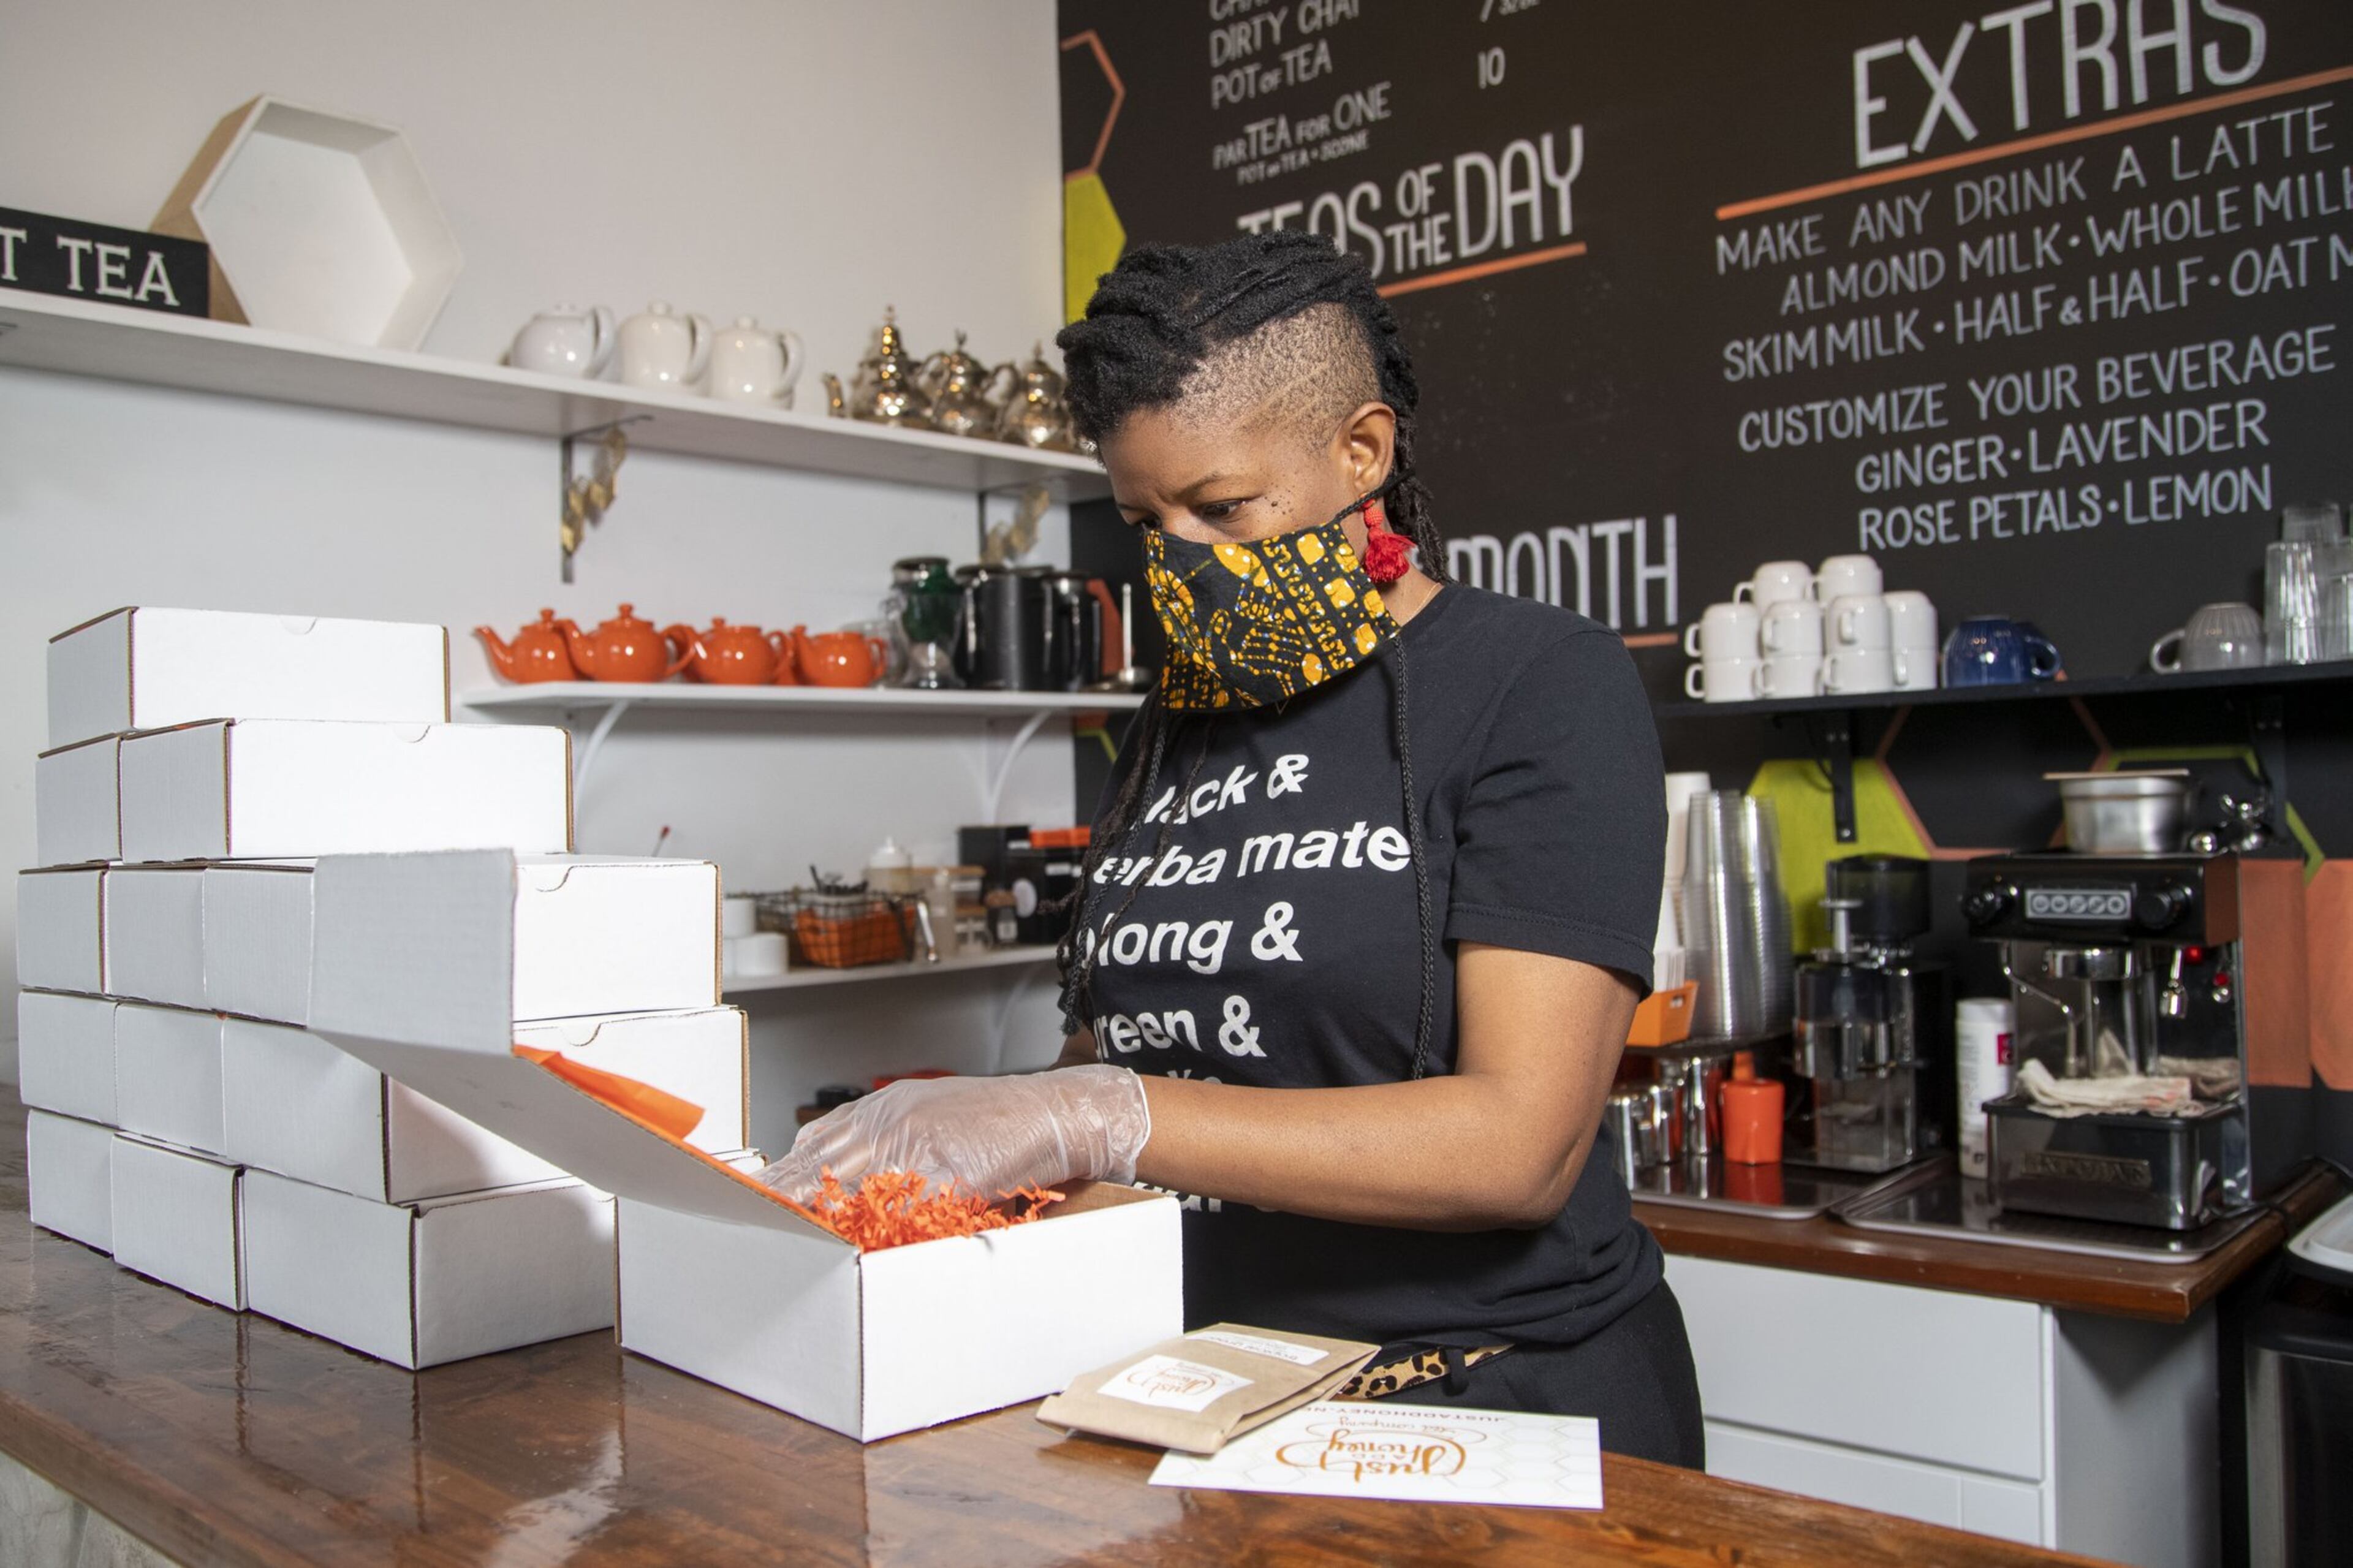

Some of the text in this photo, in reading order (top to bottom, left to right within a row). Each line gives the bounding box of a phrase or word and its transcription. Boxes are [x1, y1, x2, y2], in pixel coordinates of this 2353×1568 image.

[1210, 6, 1288, 68] DIRTY
[1211, 62, 1262, 110] POT
[1279, 38, 1332, 86] TEA
[1478, 47, 1506, 89] 10
[1295, 114, 1330, 145] FOR
[1333, 81, 1392, 131] ONE
[1853, 0, 2267, 169] EXTRAS
[1280, 148, 1310, 172] TEA
[1717, 101, 2335, 275] MAKE ANY DRINK A LATTE
[1237, 124, 1583, 279] AS OF THE DAY
[57, 235, 180, 306] TEA
[1781, 248, 1946, 316] ALMOND
[1960, 223, 2063, 282] MILK
[2086, 186, 2241, 257] WHOLE
[1722, 326, 1818, 382] SKIM
[1825, 309, 1925, 366] MILK
[1955, 284, 2056, 344] HALF
[2089, 256, 2203, 322] HALF
[2229, 237, 2319, 297] OAT
[1738, 324, 2336, 452] CUSTOMIZE YOUR BEVERAGE
[1855, 398, 2270, 493] GINGER LAVENDER
[1859, 463, 2272, 551] ROSE PETALS LEMON
[1131, 754, 1309, 830] lack &
[1093, 821, 1411, 887] erba mate
[1251, 901, 1303, 962] &
[1094, 995, 1267, 1060] reen &
